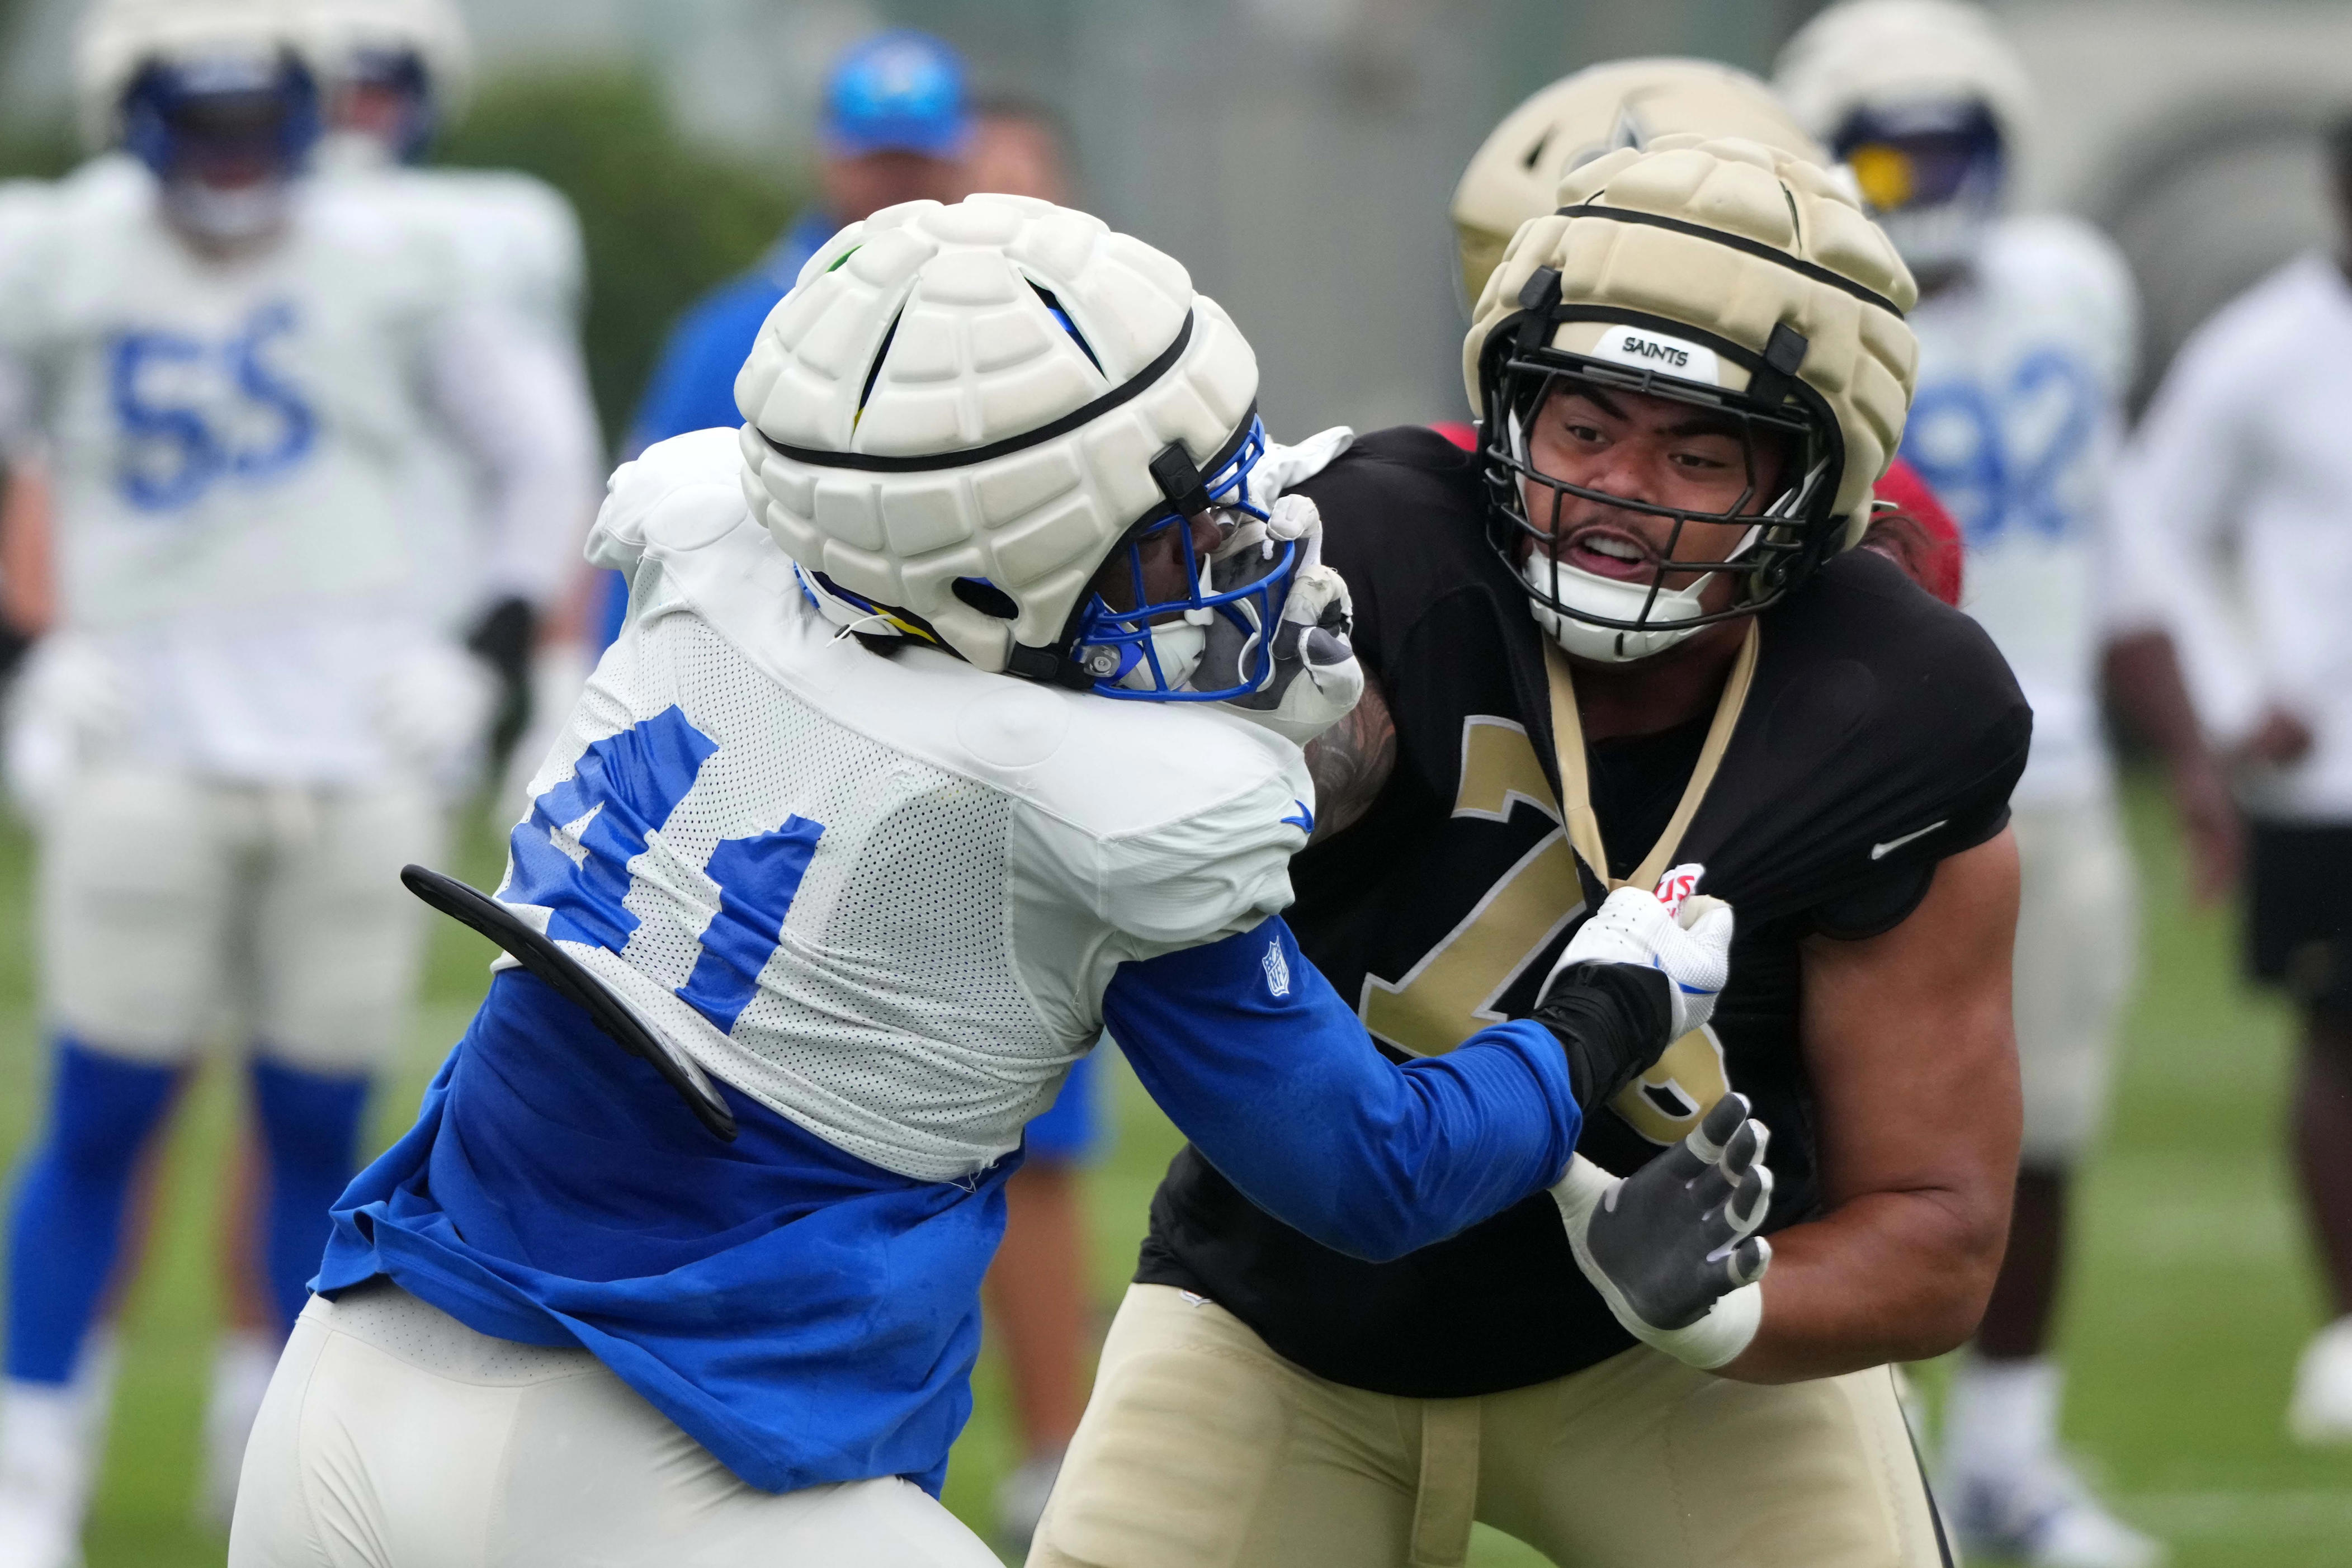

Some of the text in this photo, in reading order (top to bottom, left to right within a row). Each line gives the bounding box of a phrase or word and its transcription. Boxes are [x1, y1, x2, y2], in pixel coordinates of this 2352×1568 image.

[105, 305, 314, 512] 55
[1622, 337, 1689, 367] SAINTS
[495, 703, 826, 1037] 41
